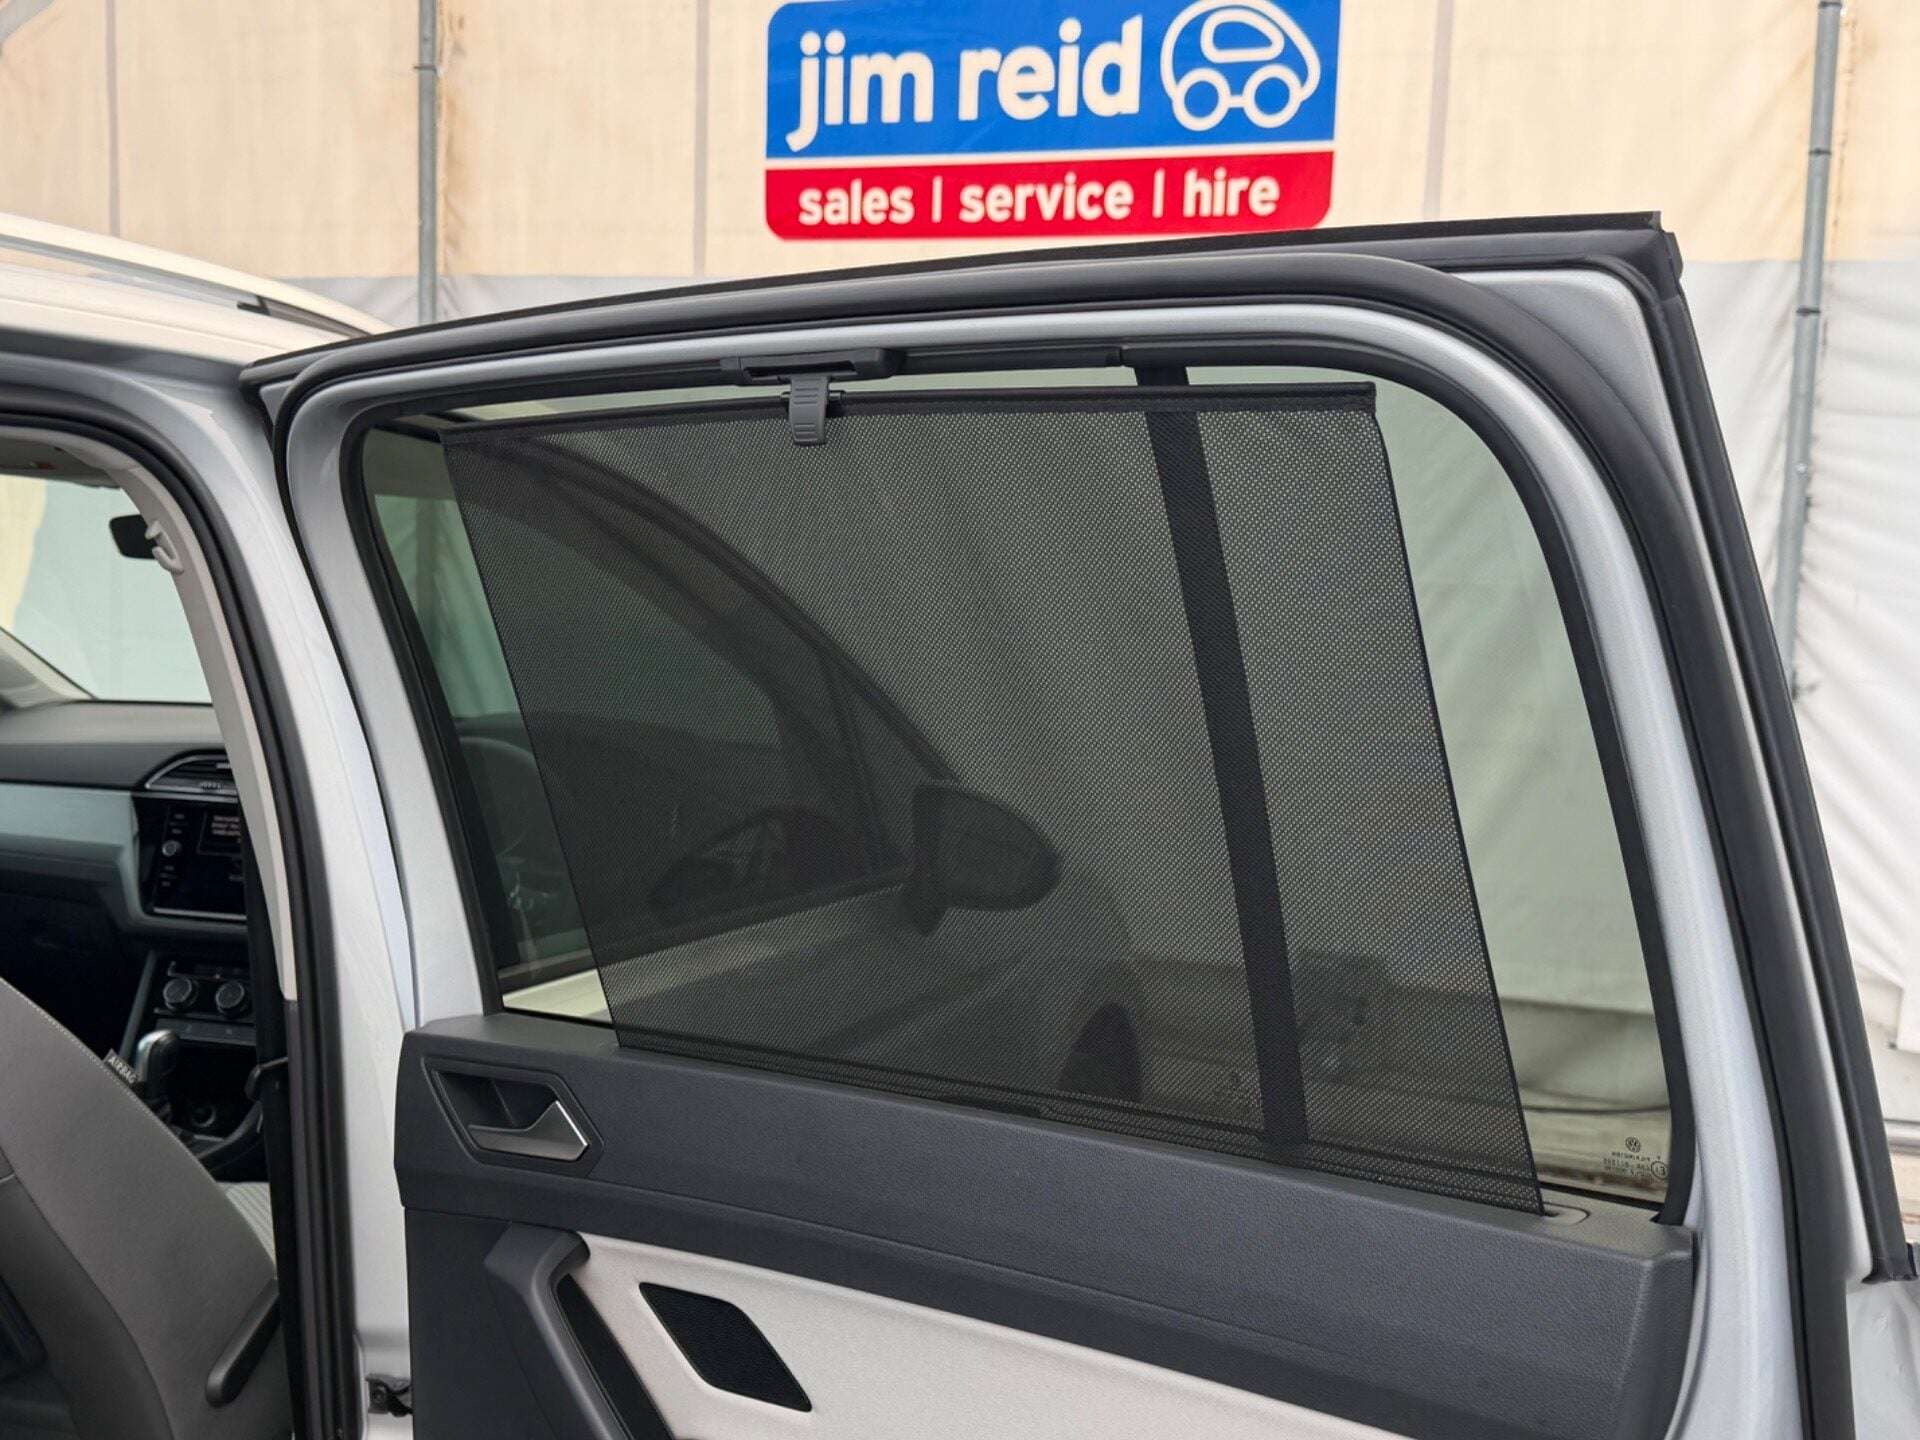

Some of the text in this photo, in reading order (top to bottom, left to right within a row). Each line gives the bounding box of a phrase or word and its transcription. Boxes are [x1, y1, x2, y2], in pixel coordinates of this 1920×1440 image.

[785, 14, 1144, 153] jim reid
[799, 179, 915, 226] sales
[958, 171, 1135, 223] service
[1183, 167, 1281, 218] hire
[108, 1056, 137, 1084] AIRBAG
